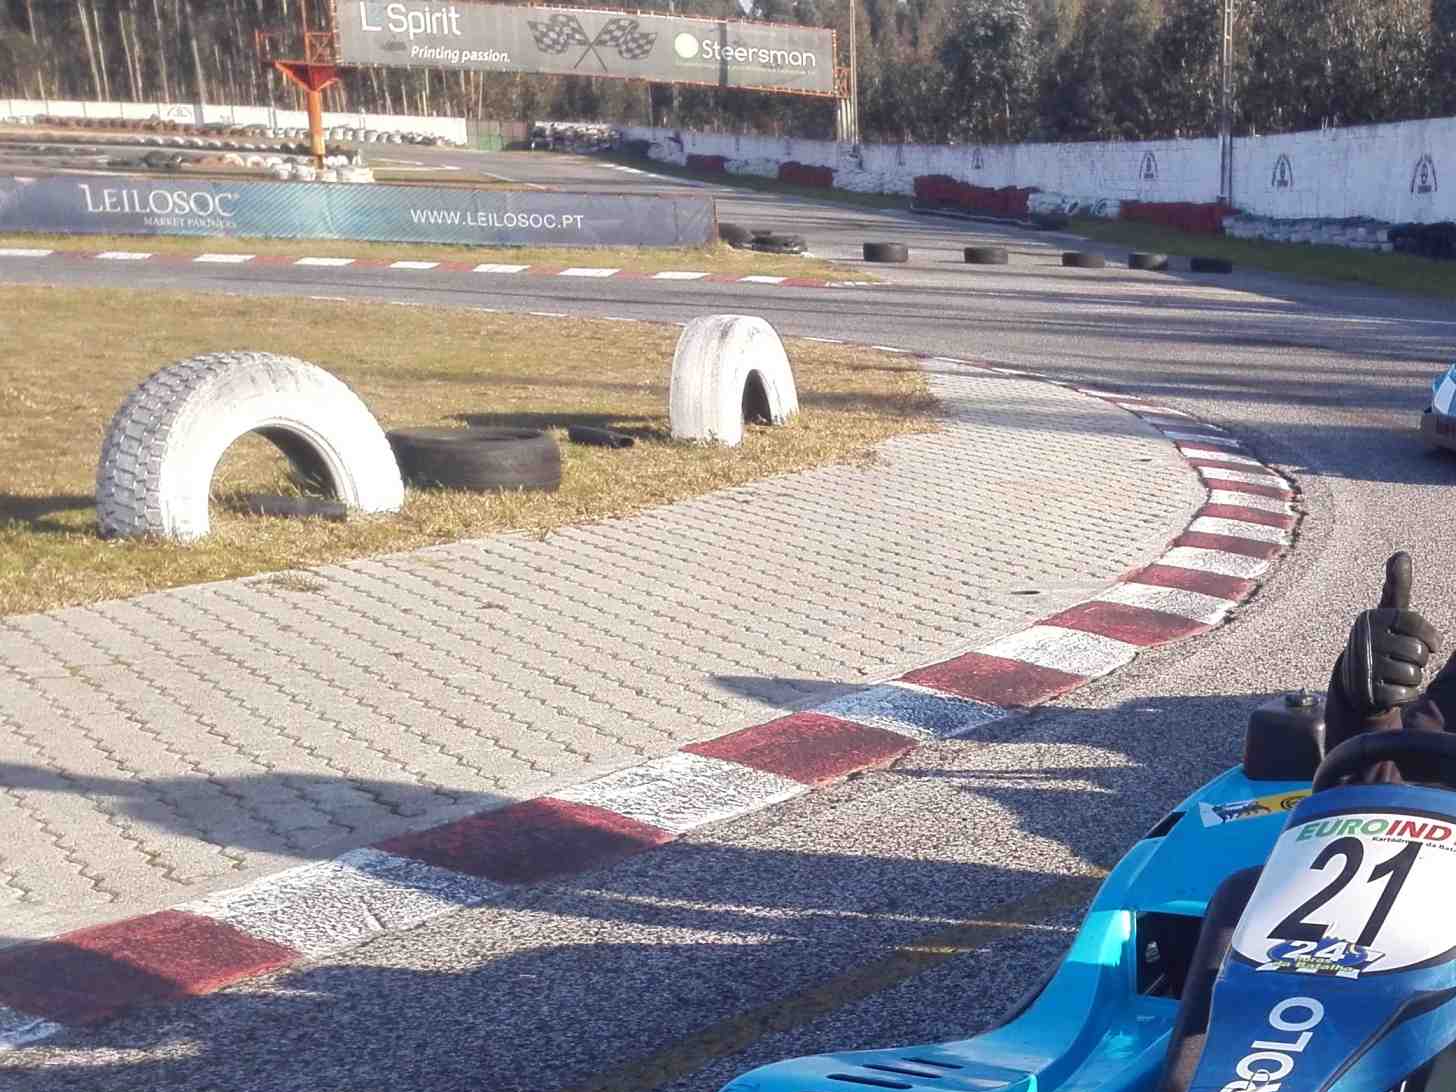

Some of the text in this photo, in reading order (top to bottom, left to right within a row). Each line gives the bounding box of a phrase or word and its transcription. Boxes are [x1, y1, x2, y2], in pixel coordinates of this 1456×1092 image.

[386, 2, 462, 40] Spirit
[411, 44, 511, 64] Printing passion.
[702, 39, 816, 67] Steersman
[78, 183, 237, 217] LEILOSOC
[410, 208, 585, 231] WWW.LEILOSOC.PT
[1266, 835, 1423, 948] 21
